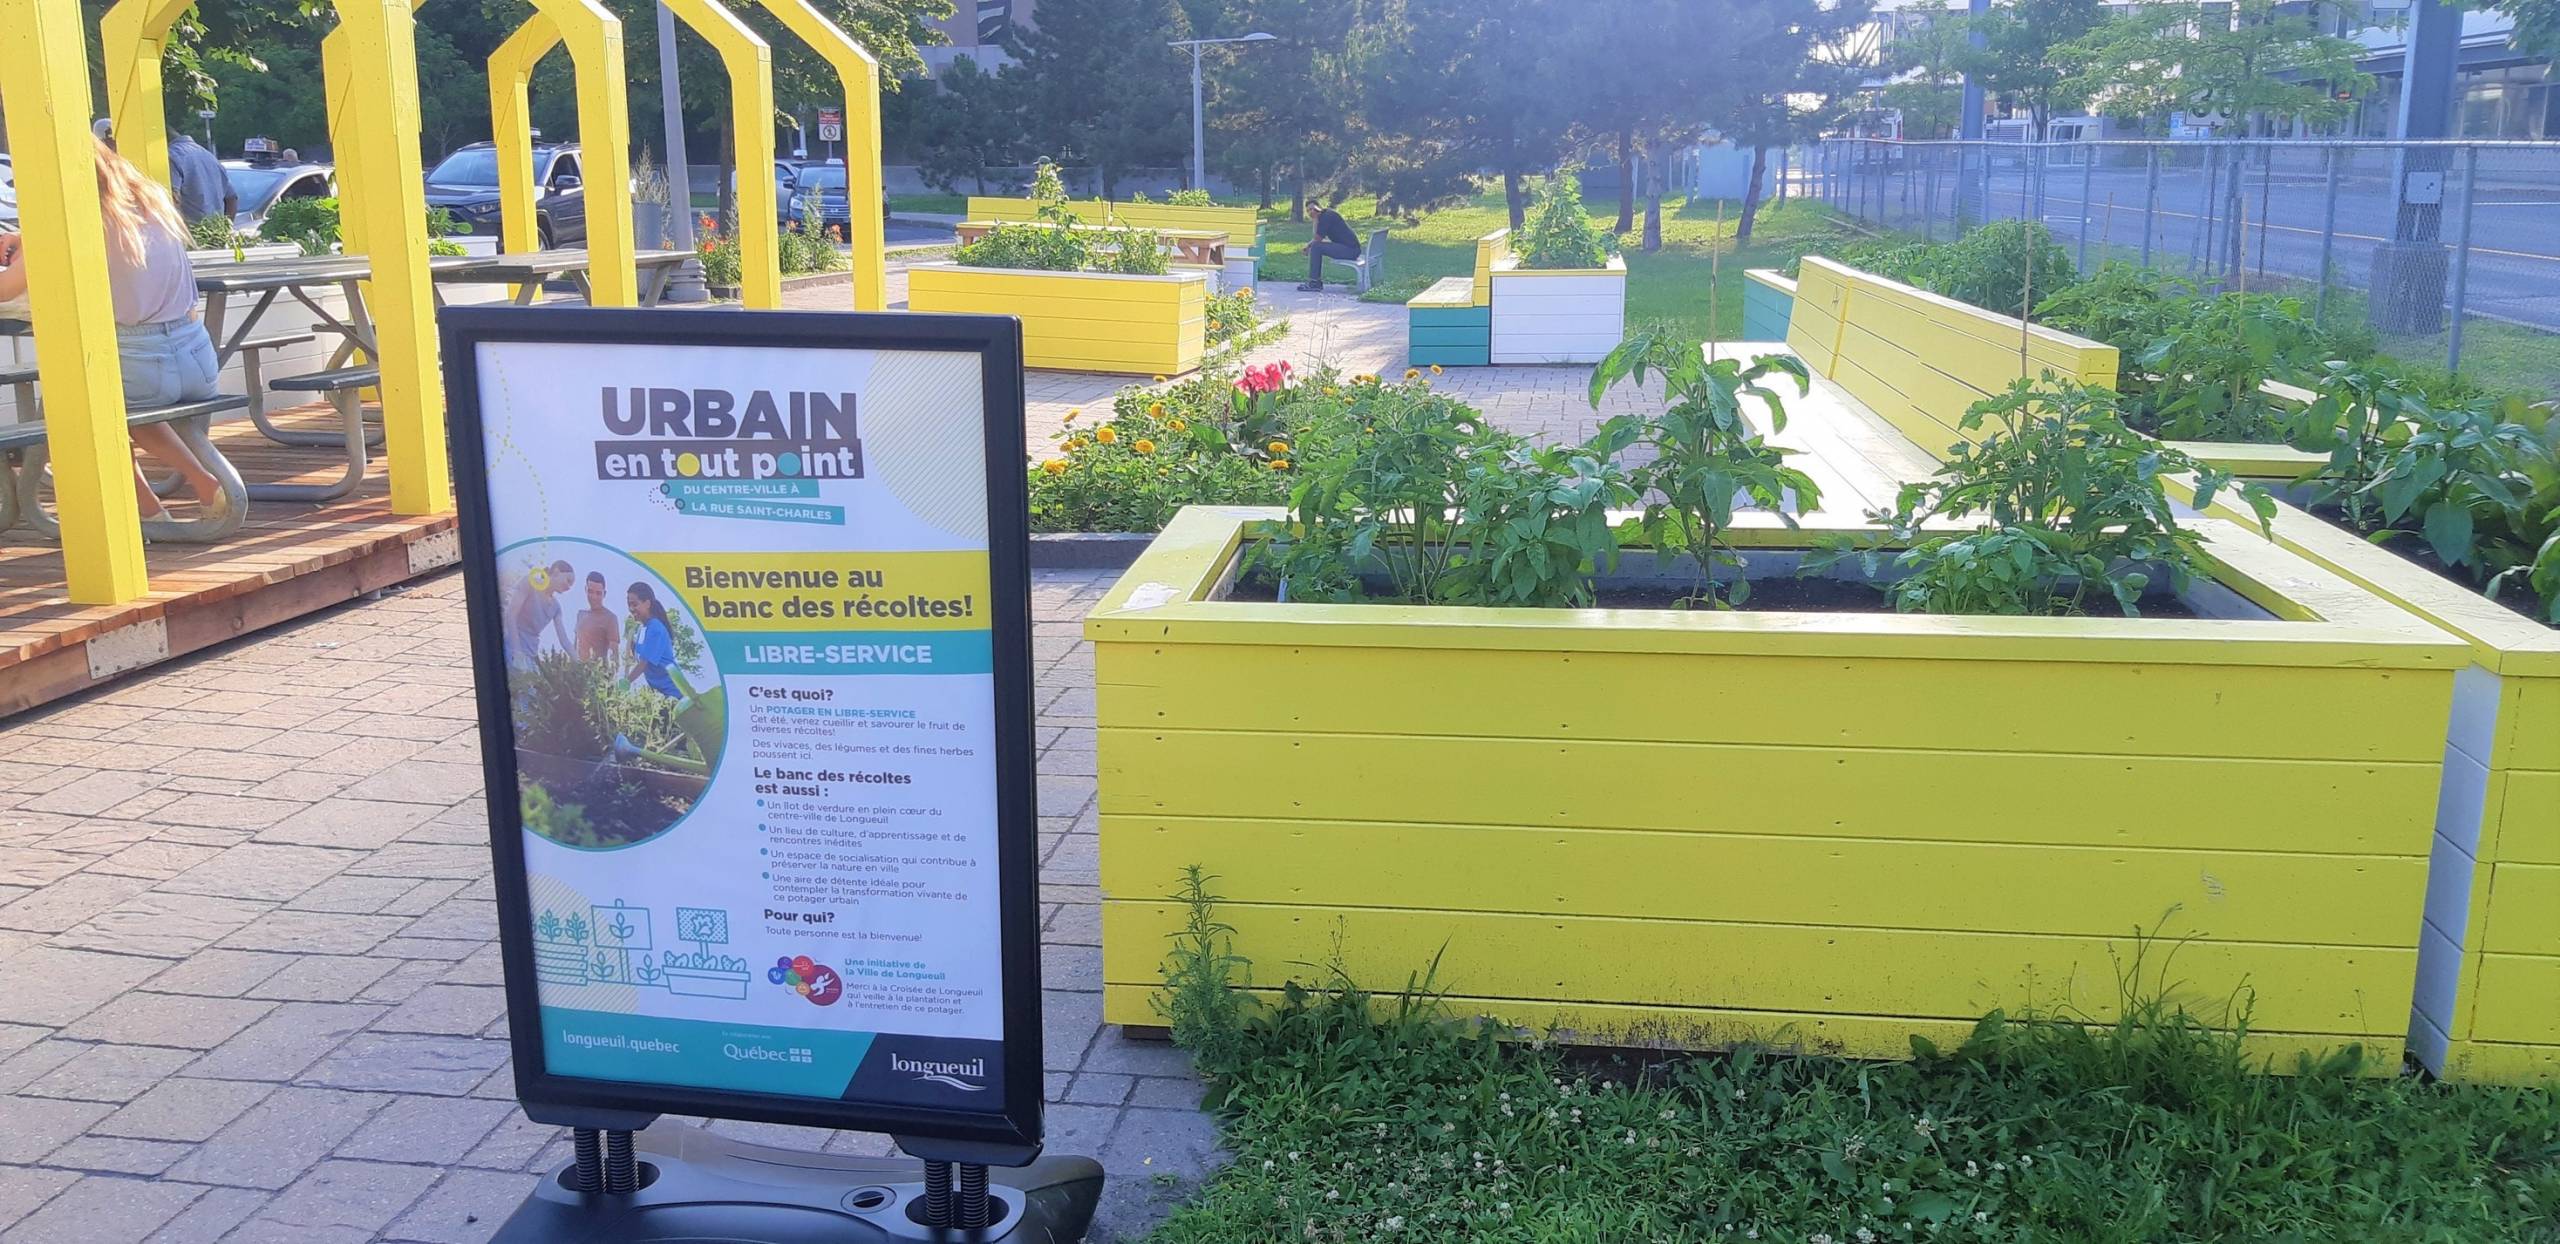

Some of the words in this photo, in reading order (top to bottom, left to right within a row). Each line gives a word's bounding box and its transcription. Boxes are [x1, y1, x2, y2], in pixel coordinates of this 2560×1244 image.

[602, 387, 857, 440] URBAIN
[605, 453, 650, 477] en
[661, 448, 740, 477] tout
[752, 446, 855, 479] point
[684, 485, 700, 494] DU
[704, 484, 787, 495] CENTRE-VILLE
[791, 481, 799, 494] À
[692, 503, 706, 512] LA
[710, 504, 733, 513] RUE
[737, 506, 831, 520] SAINT-CHARLES
[685, 566, 839, 589] Bienvenue
[848, 569, 883, 588] au
[702, 596, 773, 618] banc
[782, 596, 834, 618] des
[844, 595, 972, 618] récoltes!
[745, 645, 932, 664] LIBRE-SERVICE
[749, 686, 786, 699] C'est
[792, 689, 833, 702] quoi?
[766, 706, 815, 715] POTAGER
[818, 708, 831, 716] EN
[835, 708, 916, 718] LIBRE-SERVICE
[751, 715, 768, 723] Cet
[823, 718, 854, 727] cueillir
[858, 720, 868, 728] et
[871, 721, 914, 729] savourer
[918, 720, 925, 729] le
[929, 721, 948, 730] fruit
[952, 722, 965, 731] de
[752, 725, 791, 734] diverses
[794, 726, 835, 736] récoltes!
[753, 740, 771, 748] Des
[774, 741, 811, 750] vivaces,
[815, 742, 832, 750] des
[835, 743, 876, 754] légumes
[880, 745, 890, 753] et
[894, 745, 910, 754] des
[914, 745, 936, 754] fines
[940, 747, 973, 756] herbes
[753, 751, 797, 761] poussent
[800, 751, 814, 760] ici.
[754, 768, 771, 778] Le
[777, 768, 812, 780] banc
[818, 770, 844, 782] des
[849, 771, 911, 784] récoltes
[756, 784, 778, 794] est
[782, 785, 819, 796] aussi
[768, 801, 781, 810] Un
[803, 803, 815, 811] de
[818, 804, 854, 813] verdure
[873, 804, 896, 816] plein
[900, 808, 925, 816] cœur
[929, 808, 942, 816] du
[768, 812, 821, 820] centre-ville
[825, 813, 836, 821] de
[840, 814, 888, 824] Longueuil
[769, 826, 782, 834] Un
[785, 826, 802, 835] lieu
[806, 828, 818, 836] de
[821, 828, 857, 838] culture,
[860, 830, 937, 841] d'apprentissage
[941, 832, 952, 841] et
[955, 833, 966, 842] de
[770, 836, 821, 845] rencontres
[824, 836, 862, 847] inédites
[772, 860, 817, 870] préserver
[820, 861, 828, 869] la
[832, 863, 862, 871] nature
[881, 863, 899, 872] ville
[787, 852, 821, 862] espace
[824, 852, 836, 860] de
[839, 853, 899, 864] socialisation
[902, 855, 917, 866] qui
[920, 856, 967, 866] contribue
[971, 858, 976, 867] à
[794, 875, 811, 884] aire
[815, 876, 827, 884] de
[831, 876, 867, 886] détente
[871, 877, 900, 887] idéale
[903, 880, 925, 890] pour
[773, 884, 828, 895] contempler
[831, 886, 839, 894] la
[843, 886, 914, 898] transformation
[918, 890, 952, 899] vivante
[955, 892, 967, 900] de
[788, 894, 826, 905] potager
[830, 895, 859, 905] urbain
[765, 909, 798, 921] Pour
[803, 911, 835, 924] qui?
[765, 927, 791, 935] Toute
[794, 928, 839, 939] personne
[842, 930, 855, 939] est
[859, 930, 867, 939] la
[870, 931, 922, 941] bienvenue!
[868, 960, 910, 968] initiative
[897, 971, 945, 980] Longueuil
[847, 982, 870, 990] Merci
[890, 984, 923, 993] Croisée
[940, 987, 983, 996] Longueuil
[848, 992, 860, 1000] qui
[896, 994, 903, 1002] la
[906, 995, 950, 1004] plantation
[848, 1000, 852, 1008] à
[855, 1001, 899, 1010] l'entretien
[928, 1006, 964, 1015] potager.
[563, 1029, 680, 1054] longueuil.quebec
[724, 1043, 788, 1061] Québec
[891, 1052, 984, 1078] longueuil
